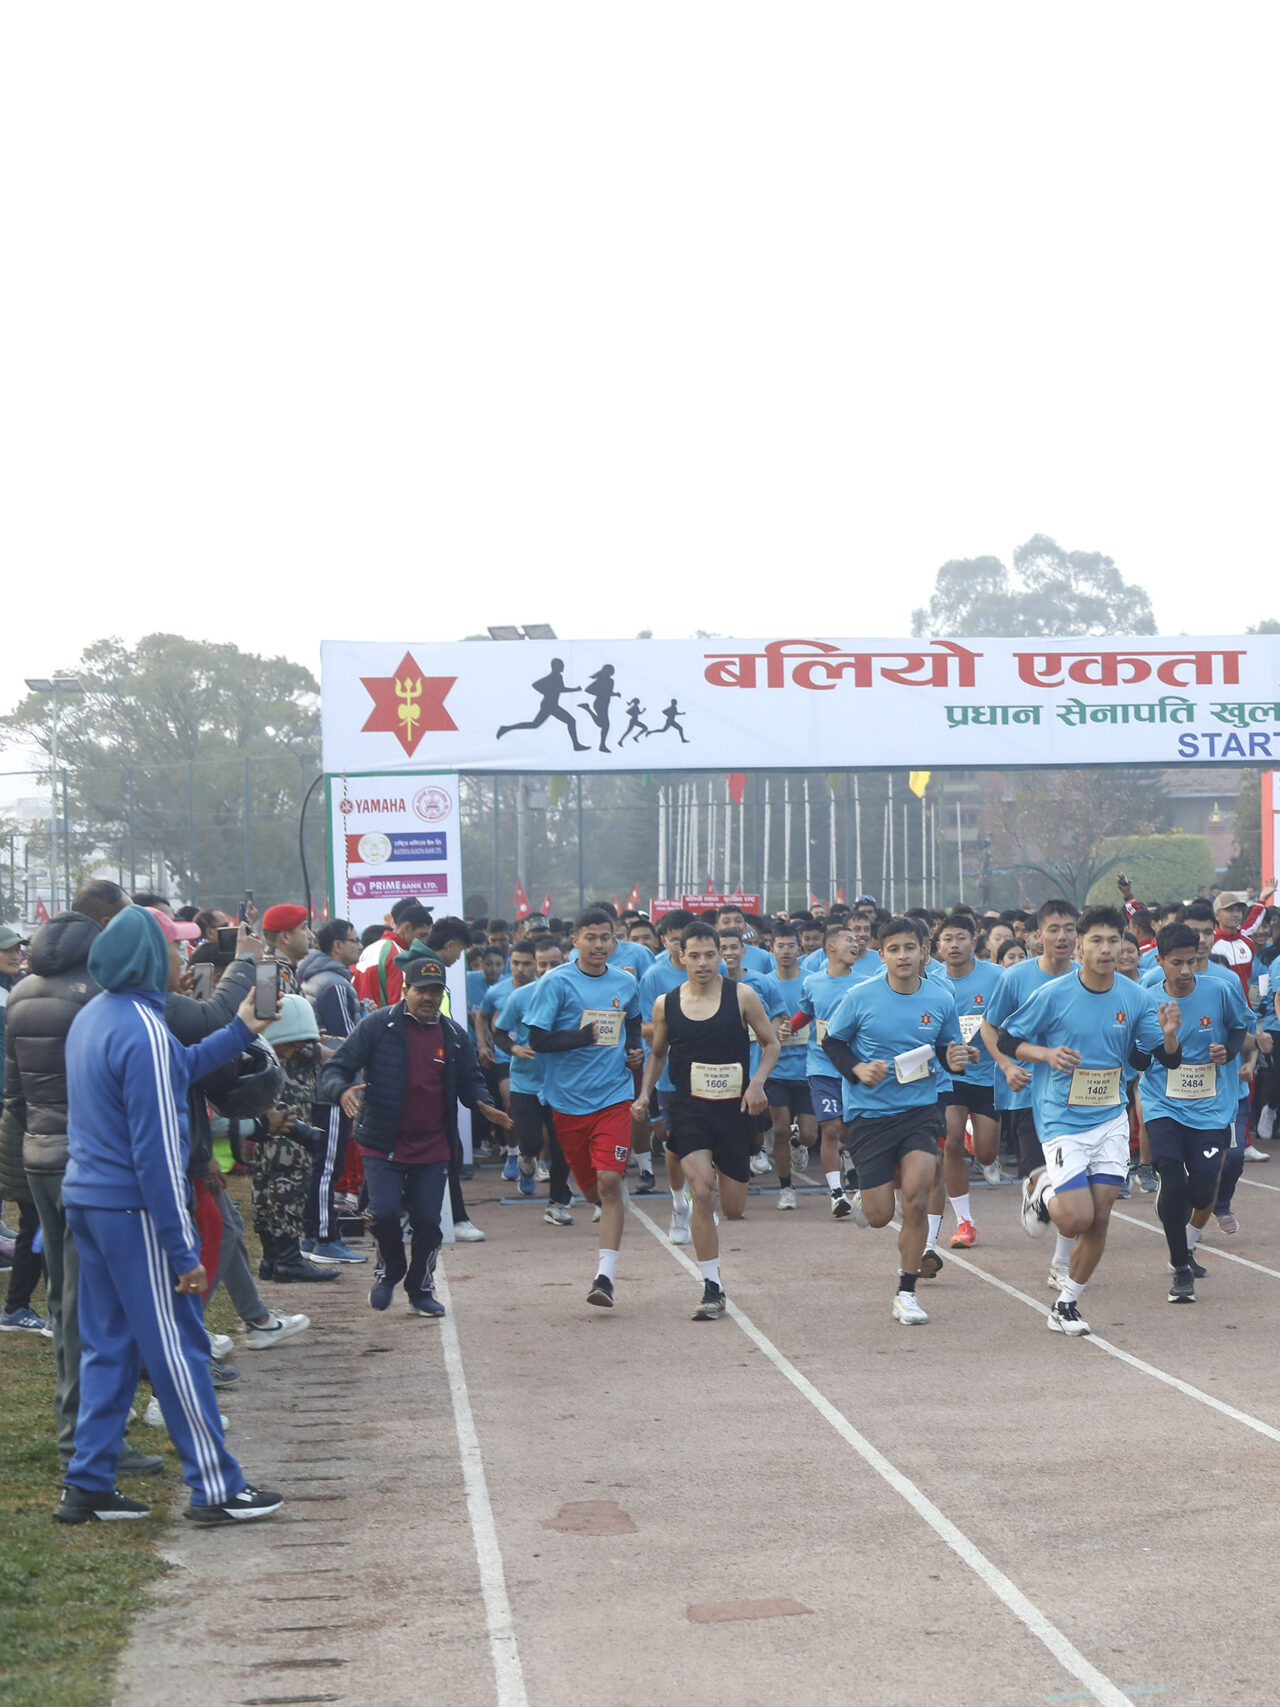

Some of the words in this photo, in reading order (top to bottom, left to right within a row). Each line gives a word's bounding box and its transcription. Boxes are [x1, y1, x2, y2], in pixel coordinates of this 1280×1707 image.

[703, 640, 984, 691] बलियो
[1012, 650, 1247, 689] एकता
[944, 705, 1044, 729] प्रधान
[1055, 696, 1197, 726] सेनापति
[355, 798, 407, 813] YAMAHA
[402, 882, 421, 890] BANK
[705, 1079, 729, 1089] 1606
[1087, 1085, 1108, 1096] 1402
[1181, 1078, 1205, 1088] 2484
[821, 1097, 839, 1113] 21
[1055, 1146, 1064, 1169] 4
